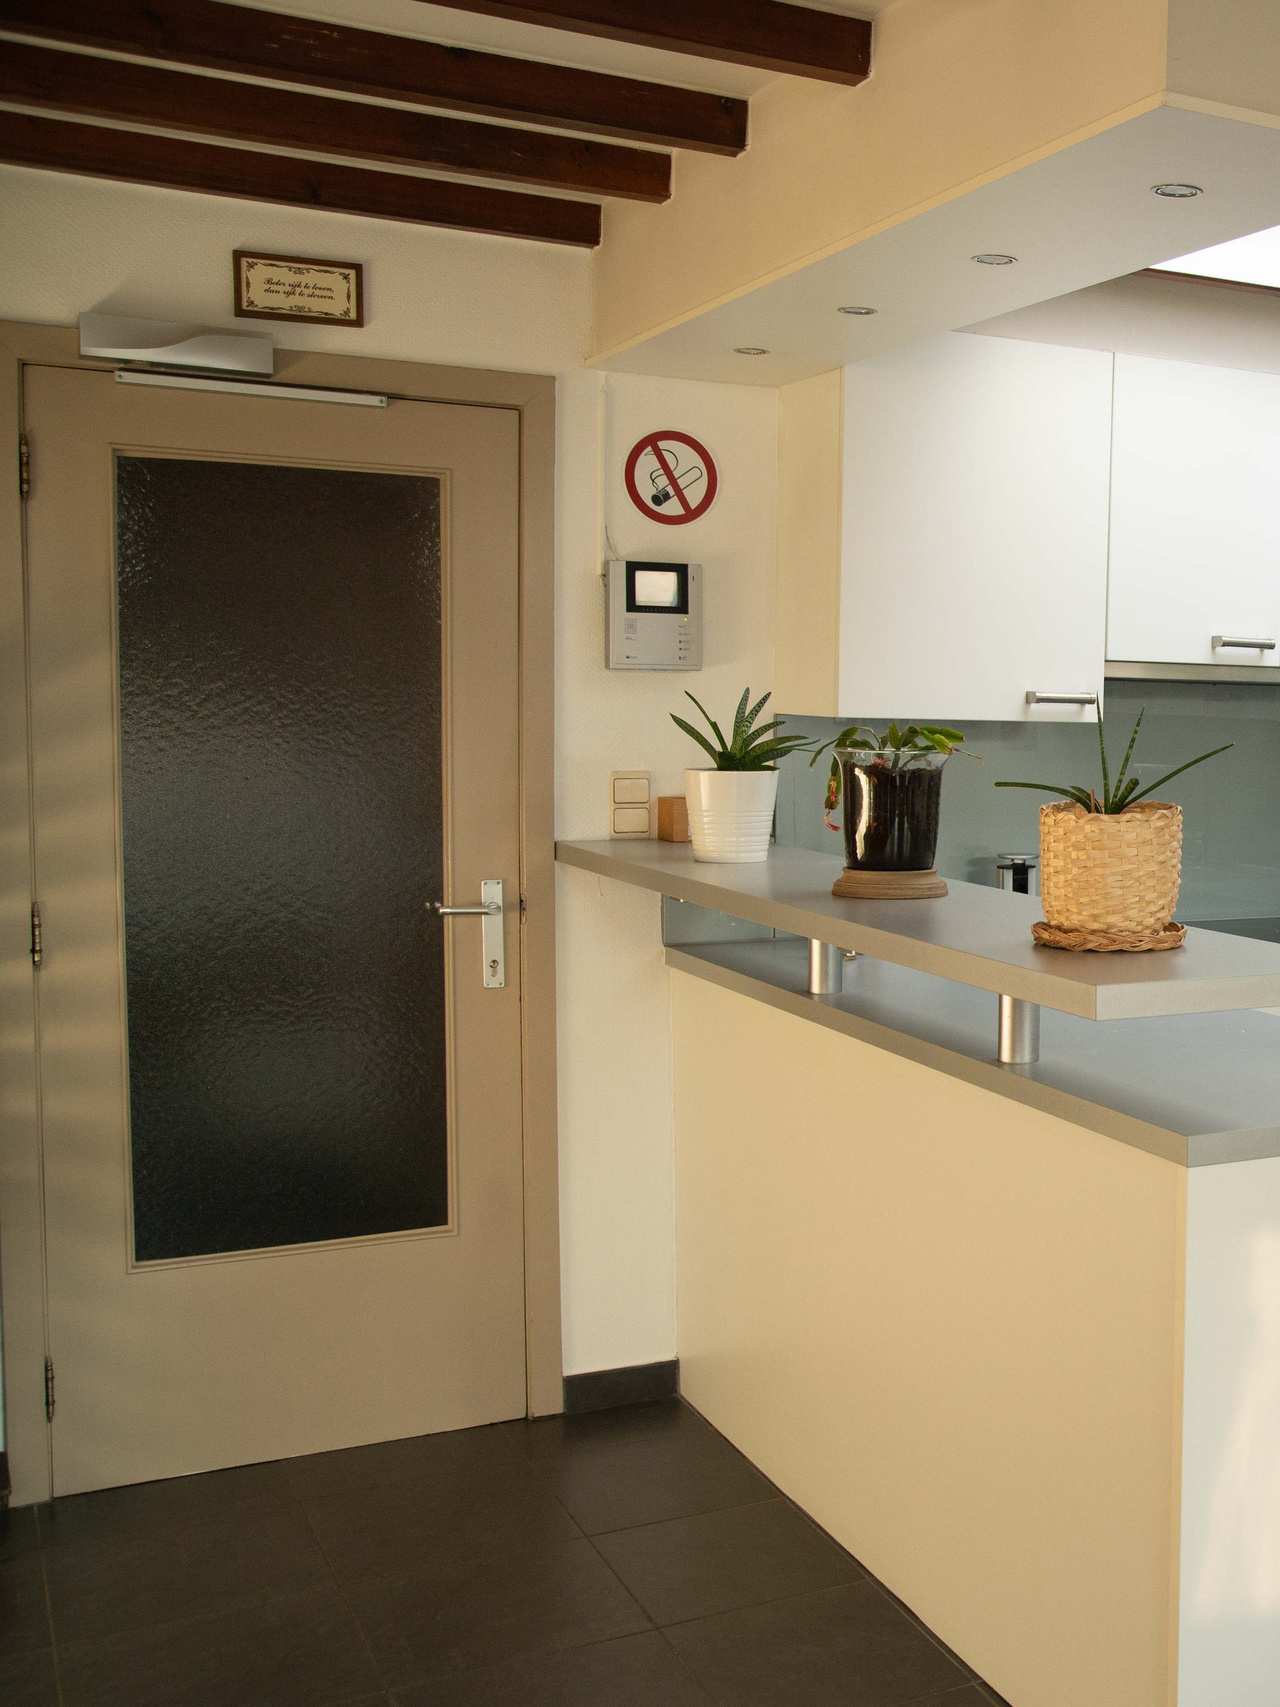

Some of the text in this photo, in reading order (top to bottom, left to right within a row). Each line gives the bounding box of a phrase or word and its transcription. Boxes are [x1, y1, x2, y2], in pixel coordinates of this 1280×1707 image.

[288, 281, 302, 290] rijk
[264, 286, 280, 294] dan
[283, 289, 297, 298] rijk
